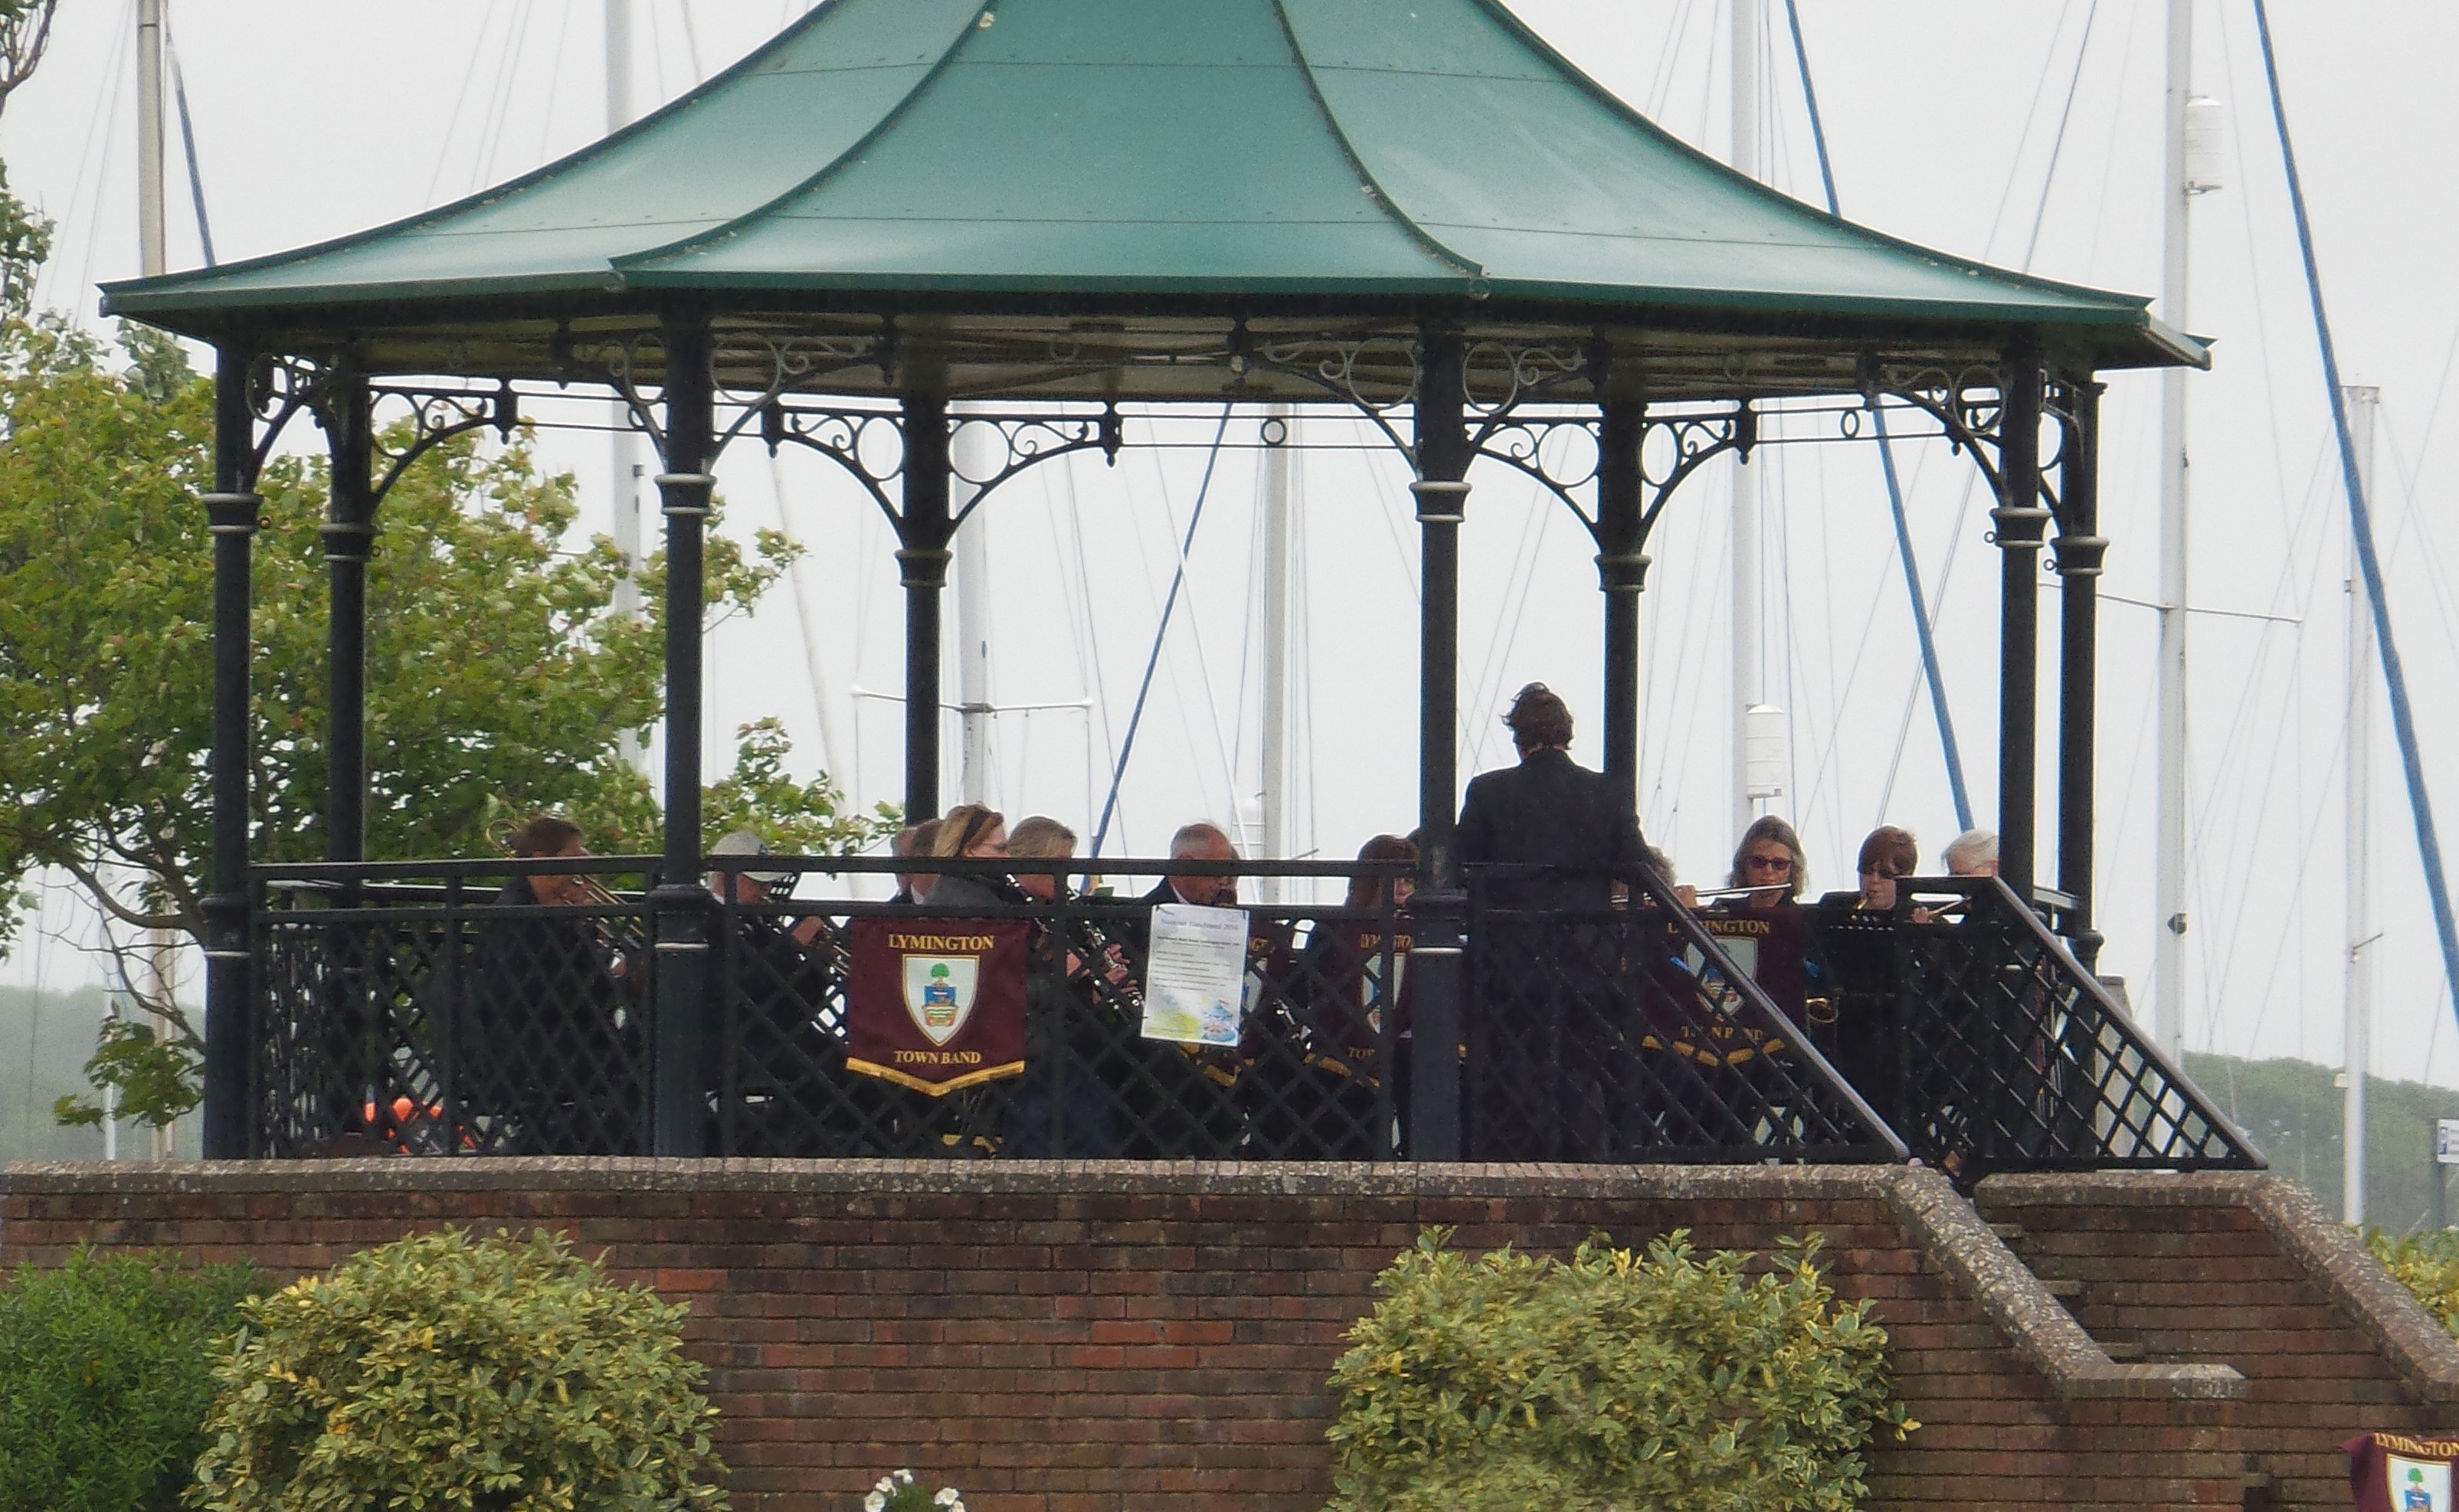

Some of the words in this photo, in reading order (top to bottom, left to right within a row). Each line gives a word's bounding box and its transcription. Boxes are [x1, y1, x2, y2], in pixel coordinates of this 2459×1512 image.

[1667, 919, 1770, 934] LINGTON
[888, 934, 995, 951] LYMINGTON
[894, 1050, 938, 1064] TOWN
[941, 1052, 981, 1065] BAND
